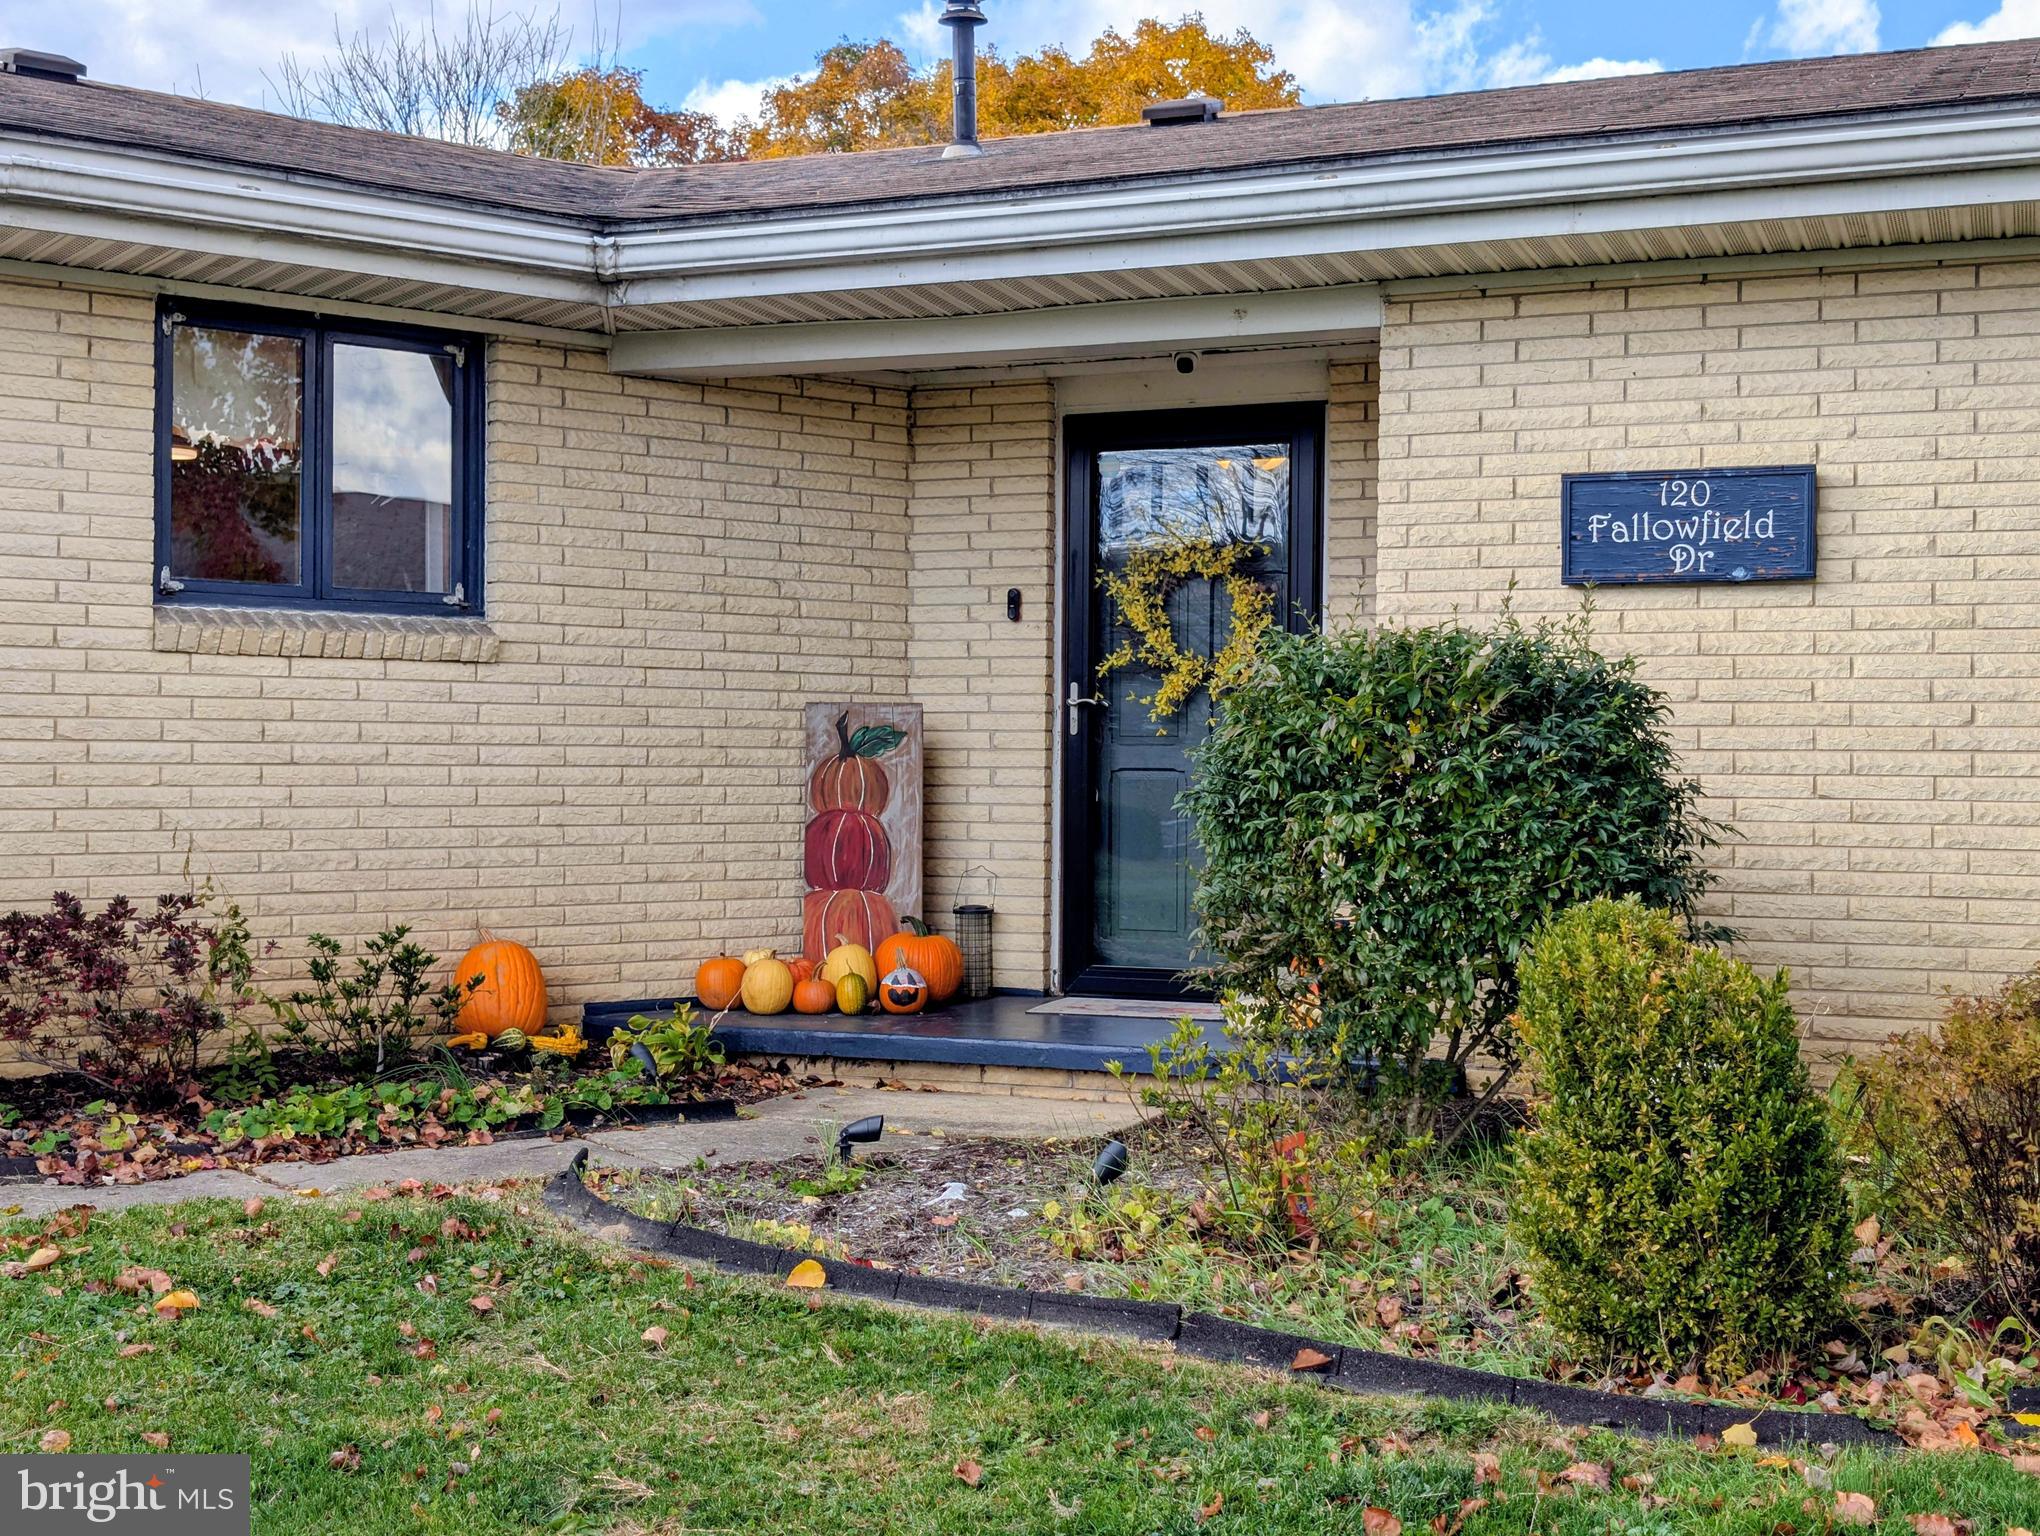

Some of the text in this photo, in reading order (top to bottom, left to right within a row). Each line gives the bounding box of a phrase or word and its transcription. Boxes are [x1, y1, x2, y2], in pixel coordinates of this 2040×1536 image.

[1660, 480, 1710, 506] 120
[1588, 509, 1775, 545] Fallowfield
[1669, 544, 1714, 573] Dr
